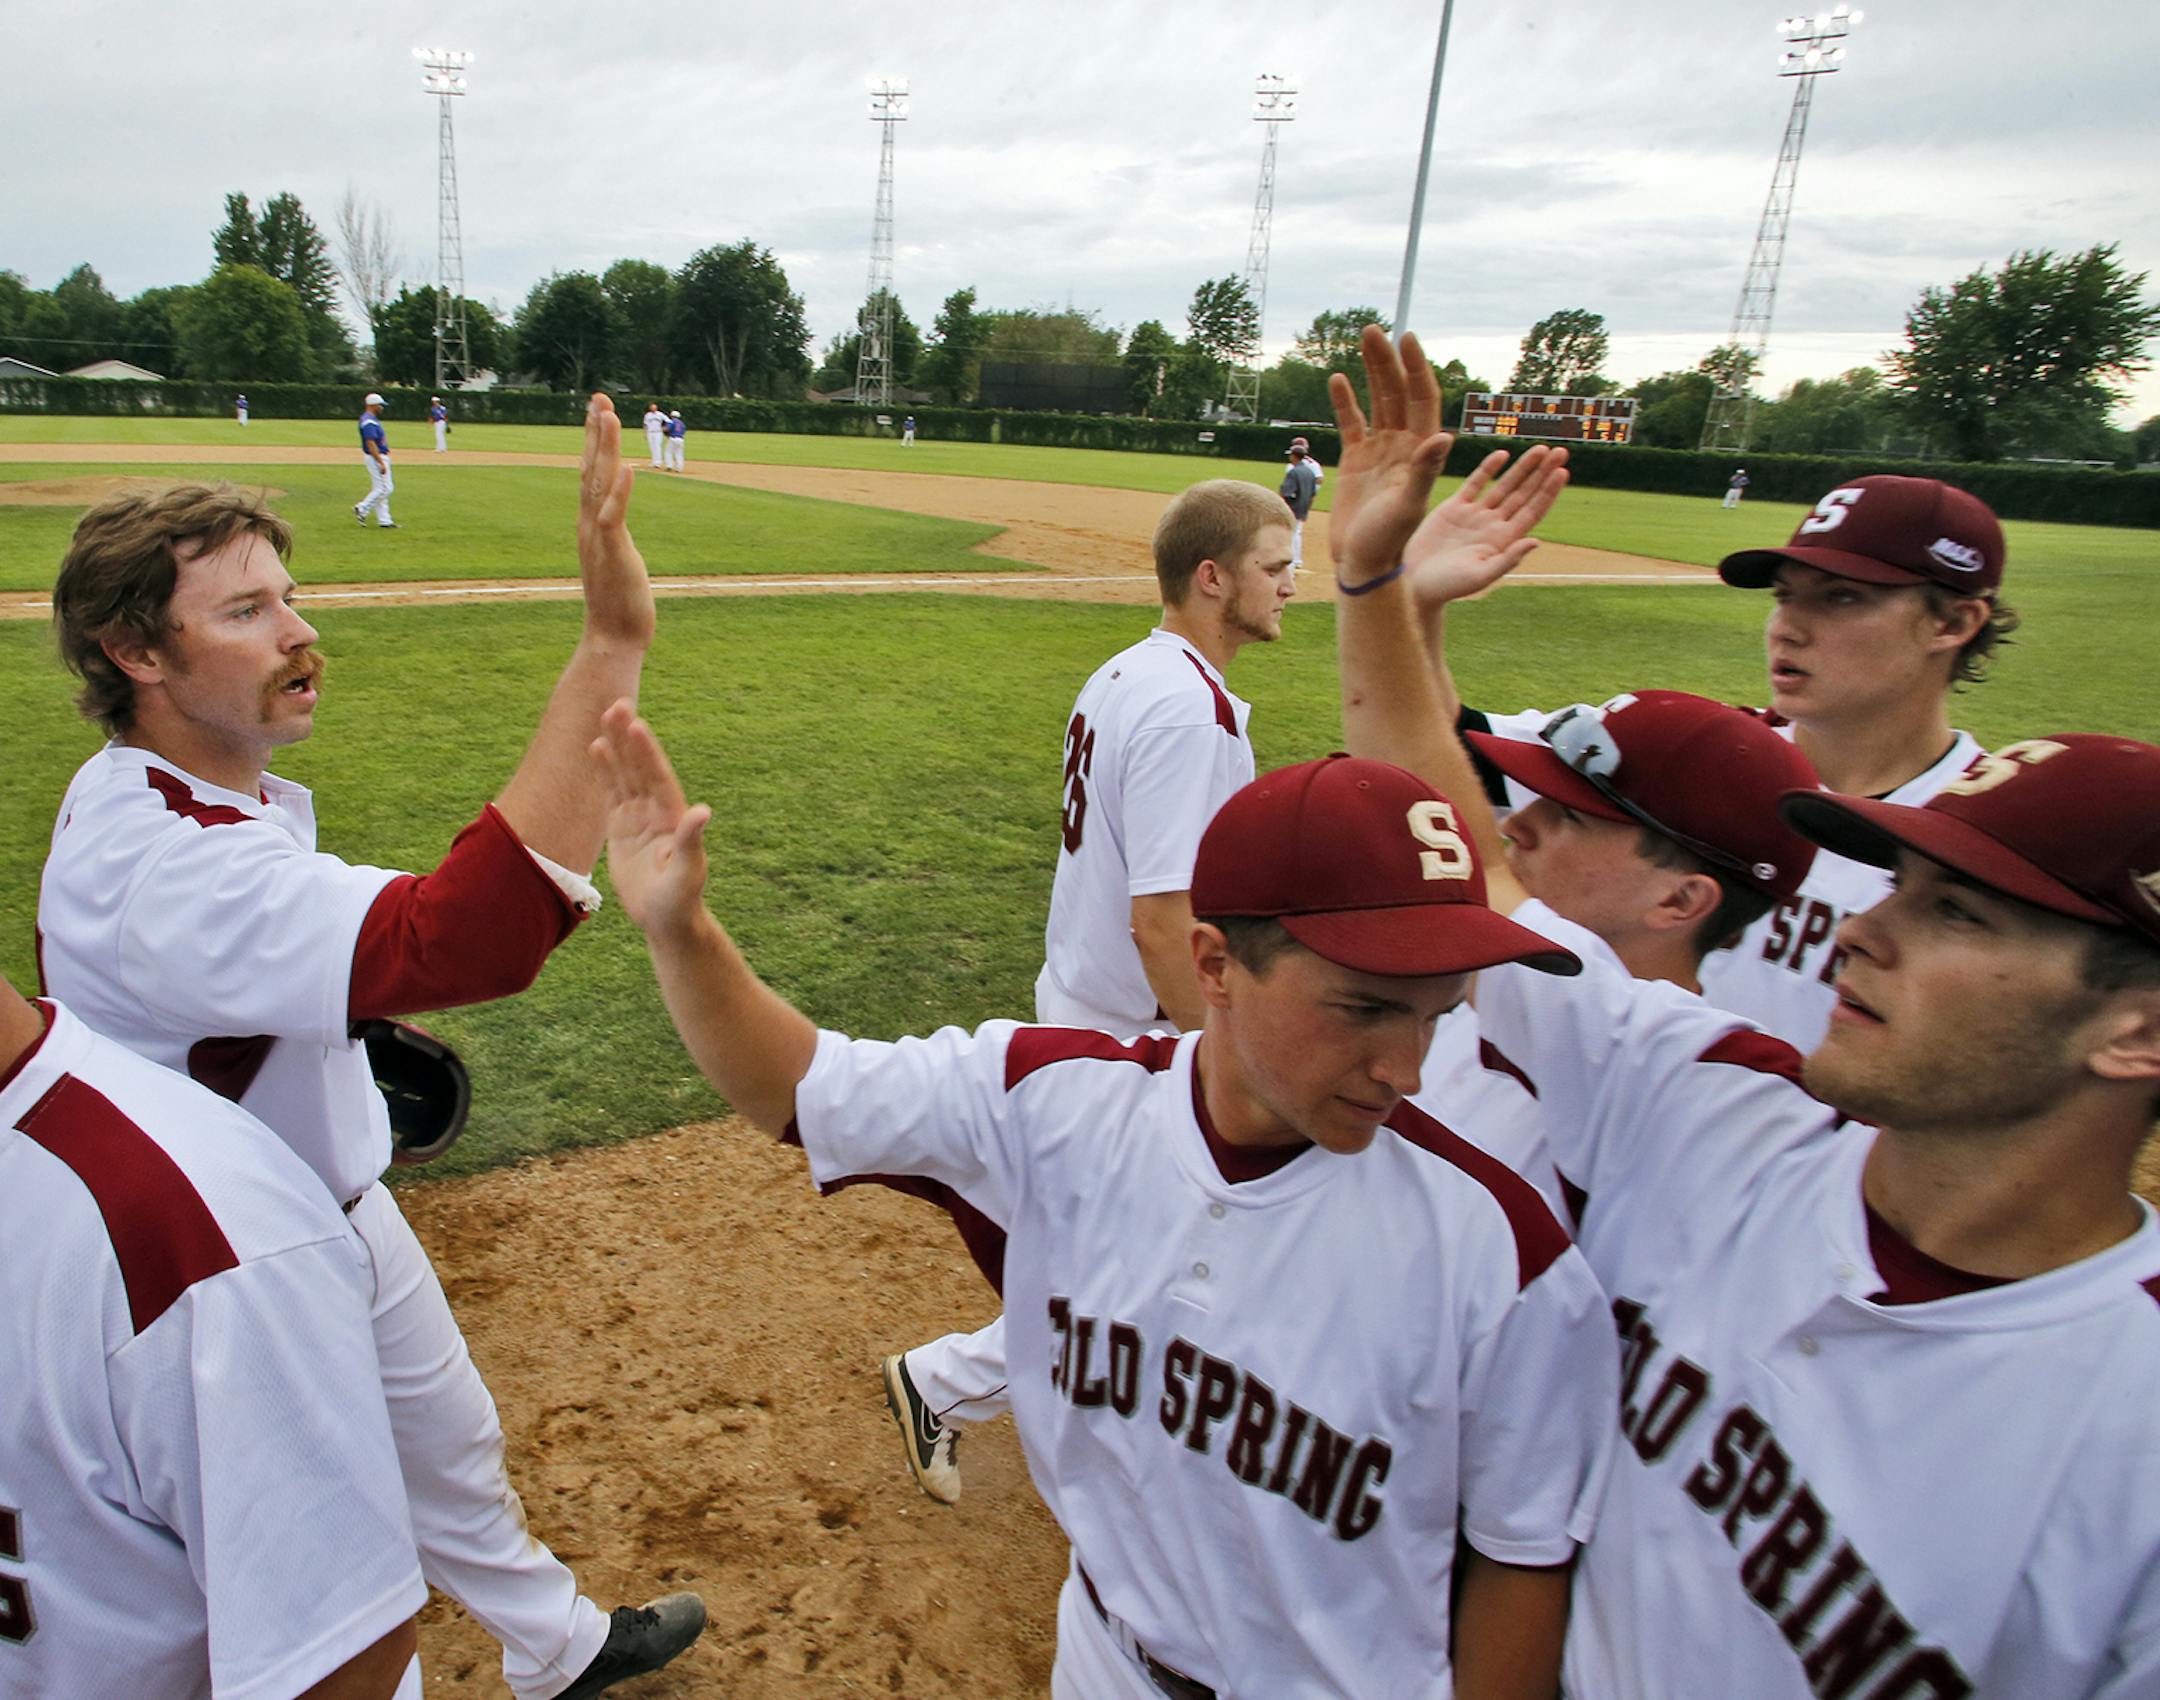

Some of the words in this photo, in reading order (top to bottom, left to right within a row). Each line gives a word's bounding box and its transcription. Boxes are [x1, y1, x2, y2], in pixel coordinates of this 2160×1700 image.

[1800, 487, 1866, 535] S
[1406, 800, 1474, 881] S
[1159, 1333, 1393, 1542] SPRING
